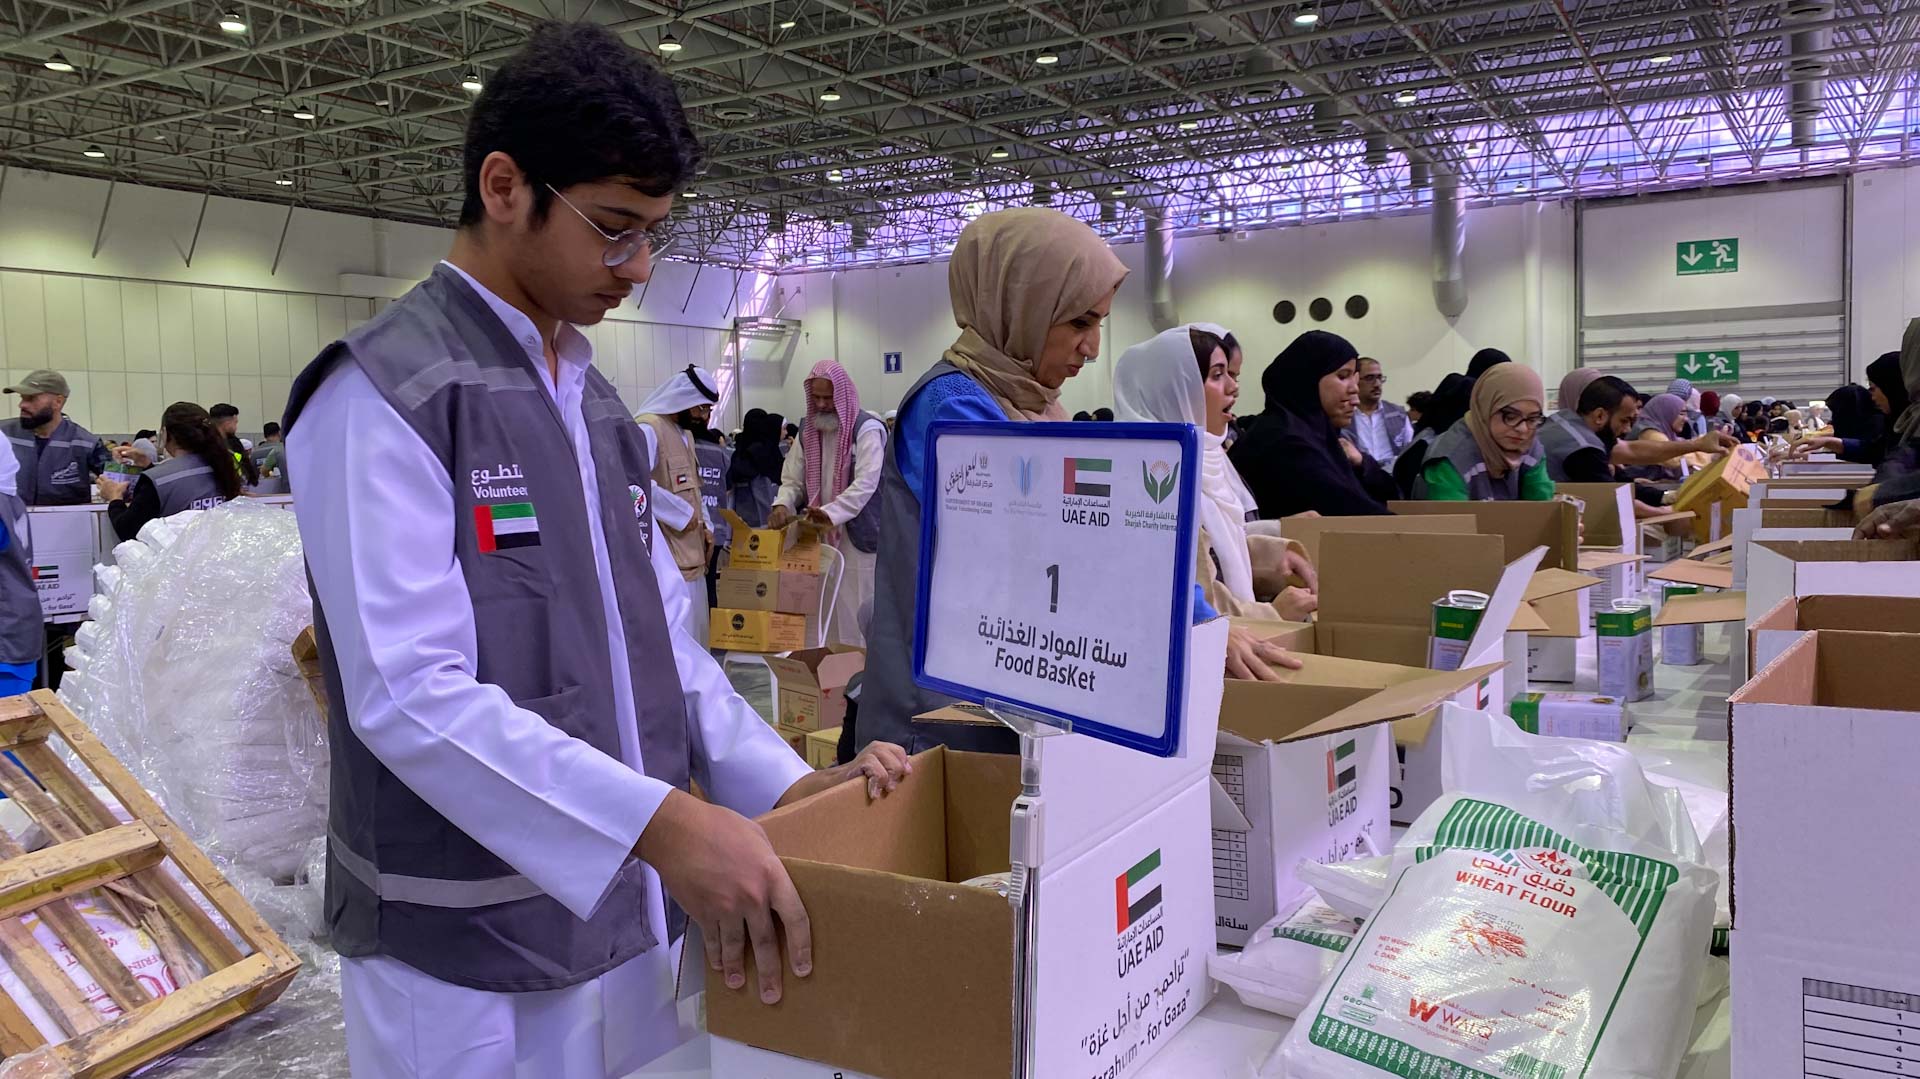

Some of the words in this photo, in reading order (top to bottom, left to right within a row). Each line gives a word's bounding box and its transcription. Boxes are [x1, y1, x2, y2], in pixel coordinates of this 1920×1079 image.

[471, 464, 524, 486] تطوع
[1062, 508, 1086, 525] UAE
[1088, 511, 1110, 527] AID
[1124, 519, 1141, 528] Sharjah
[1142, 520, 1159, 530] Charity
[1046, 564, 1059, 613] 1
[978, 614, 1036, 648] الغذائية
[1040, 630, 1088, 661] المواد
[995, 648, 1034, 676] Food
[1092, 638, 1127, 668] سلة
[1328, 802, 1344, 828] UAE
[1456, 871, 1518, 896] WHEAT
[1520, 890, 1577, 918] FLOUR
[1523, 872, 1576, 897] دقيق
[1118, 941, 1142, 978] UAE
[1144, 925, 1164, 959] AID
[1113, 992, 1130, 1040] أجل
[1135, 993, 1150, 1020] من
[1147, 1020, 1162, 1045] for
[1164, 988, 1190, 1027] Gaza"
[1896, 1061, 1903, 1069] 2
